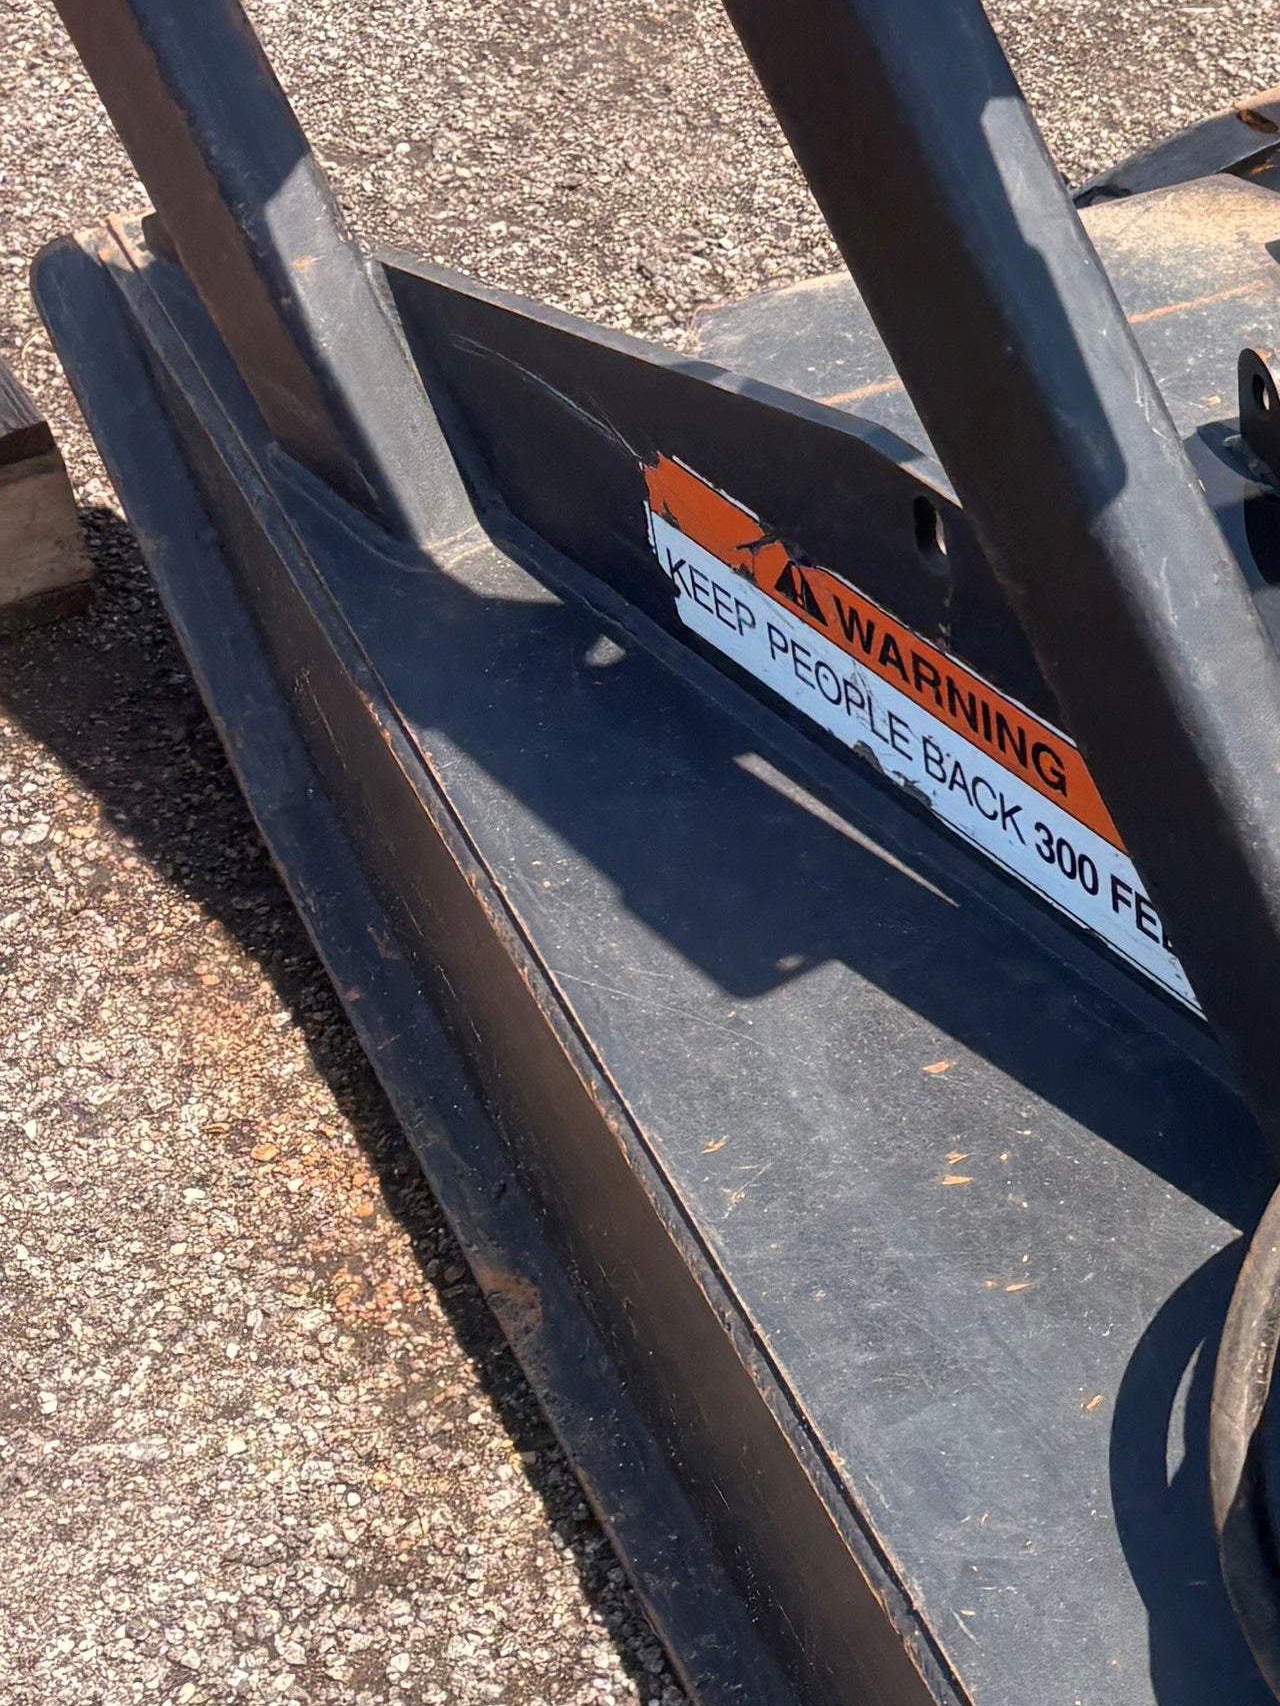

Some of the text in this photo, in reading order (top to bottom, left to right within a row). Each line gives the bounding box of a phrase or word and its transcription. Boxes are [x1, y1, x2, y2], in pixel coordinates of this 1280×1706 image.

[664, 545, 757, 636] KEEP
[768, 623, 914, 762] PEOPLE
[923, 736, 1025, 846] BACK
[1035, 821, 1100, 896] 300
[833, 594, 1068, 797] WARNING
